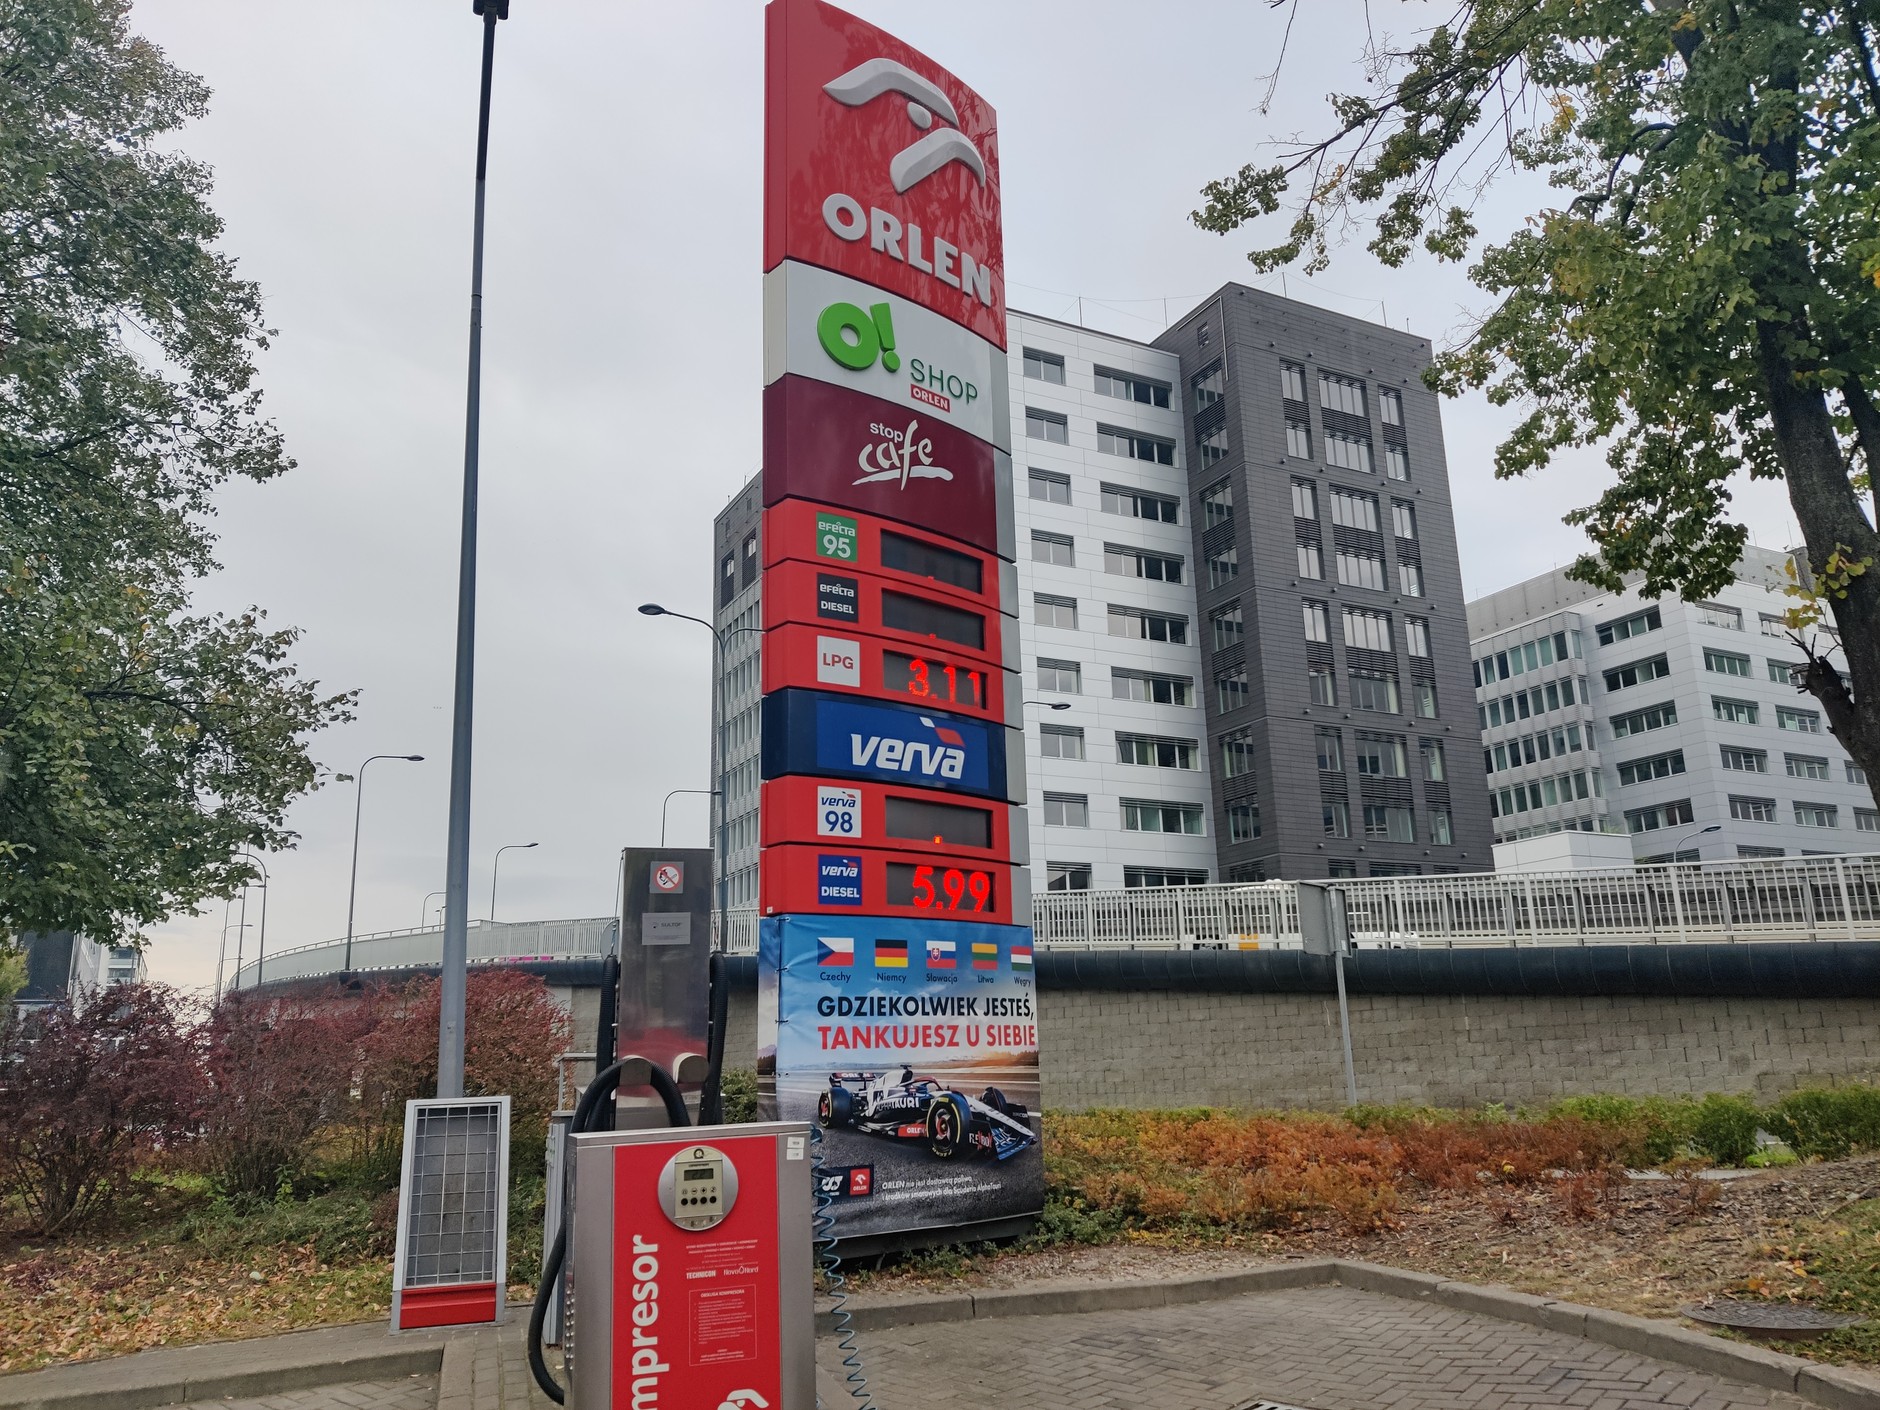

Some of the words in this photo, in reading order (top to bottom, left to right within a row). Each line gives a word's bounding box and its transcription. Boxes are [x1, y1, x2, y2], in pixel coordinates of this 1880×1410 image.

[822, 193, 992, 309] ORLEN
[910, 358, 978, 404] SHOP
[912, 388, 949, 410] ORLEN
[869, 422, 904, 443] stop
[857, 419, 936, 490] cafe
[822, 534, 852, 559] 95
[820, 600, 855, 614] DIESEL
[822, 652, 854, 670] LPG
[908, 657, 980, 704] 3.11
[850, 733, 965, 780] verva
[820, 796, 856, 808] verva
[825, 810, 853, 834] 98
[821, 864, 858, 878] verva
[821, 886, 860, 898] DIESEL
[912, 865, 990, 913] 5.99
[820, 971, 852, 983] Czechy
[876, 972, 907, 984] Niemcy
[977, 974, 994, 984] Litwa
[1013, 976, 1032, 988] Węgry
[817, 995, 978, 1017] GDZIEKOLWIEK
[983, 992, 1034, 1020] JESTEŚ,
[818, 1024, 959, 1050] TANKUJESZ
[966, 1024, 980, 1047] U
[986, 1024, 1035, 1046] SIEBIE
[882, 1180, 905, 1190] ORLEN
[916, 1179, 926, 1188] jest
[943, 1187, 953, 1195] dla
[686, 1270, 716, 1279] TECHNICON
